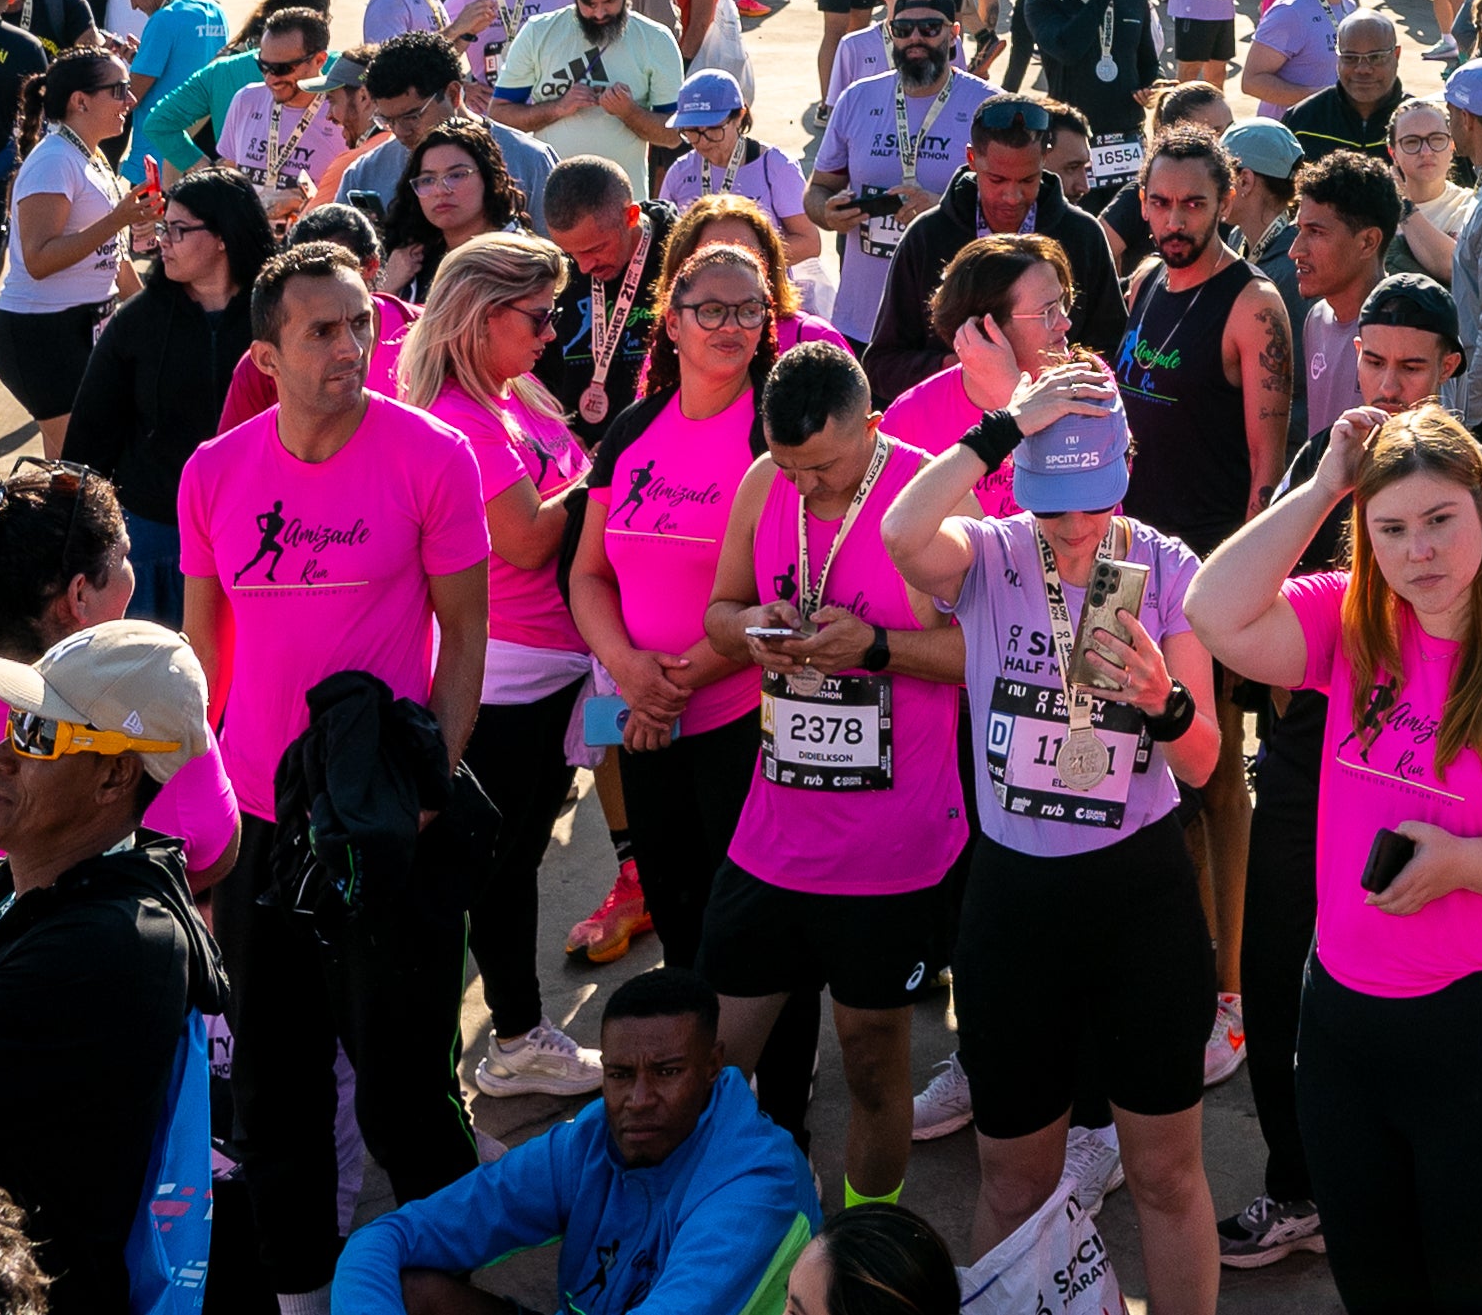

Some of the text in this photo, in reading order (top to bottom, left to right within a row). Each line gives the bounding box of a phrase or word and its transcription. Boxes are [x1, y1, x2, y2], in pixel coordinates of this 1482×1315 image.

[1097, 148, 1140, 167] 16554
[1132, 337, 1181, 370] Amizade
[1044, 451, 1100, 468] SPCITY 25
[645, 476, 723, 507] Amizade
[282, 517, 372, 552] Amizade
[652, 512, 679, 535] Run
[299, 558, 330, 586] Run
[1004, 655, 1043, 674] HALF
[790, 713, 865, 747] 2378
[992, 717, 1010, 751] D
[798, 750, 854, 764] DIDIELKSON
[1393, 747, 1426, 783] Run
